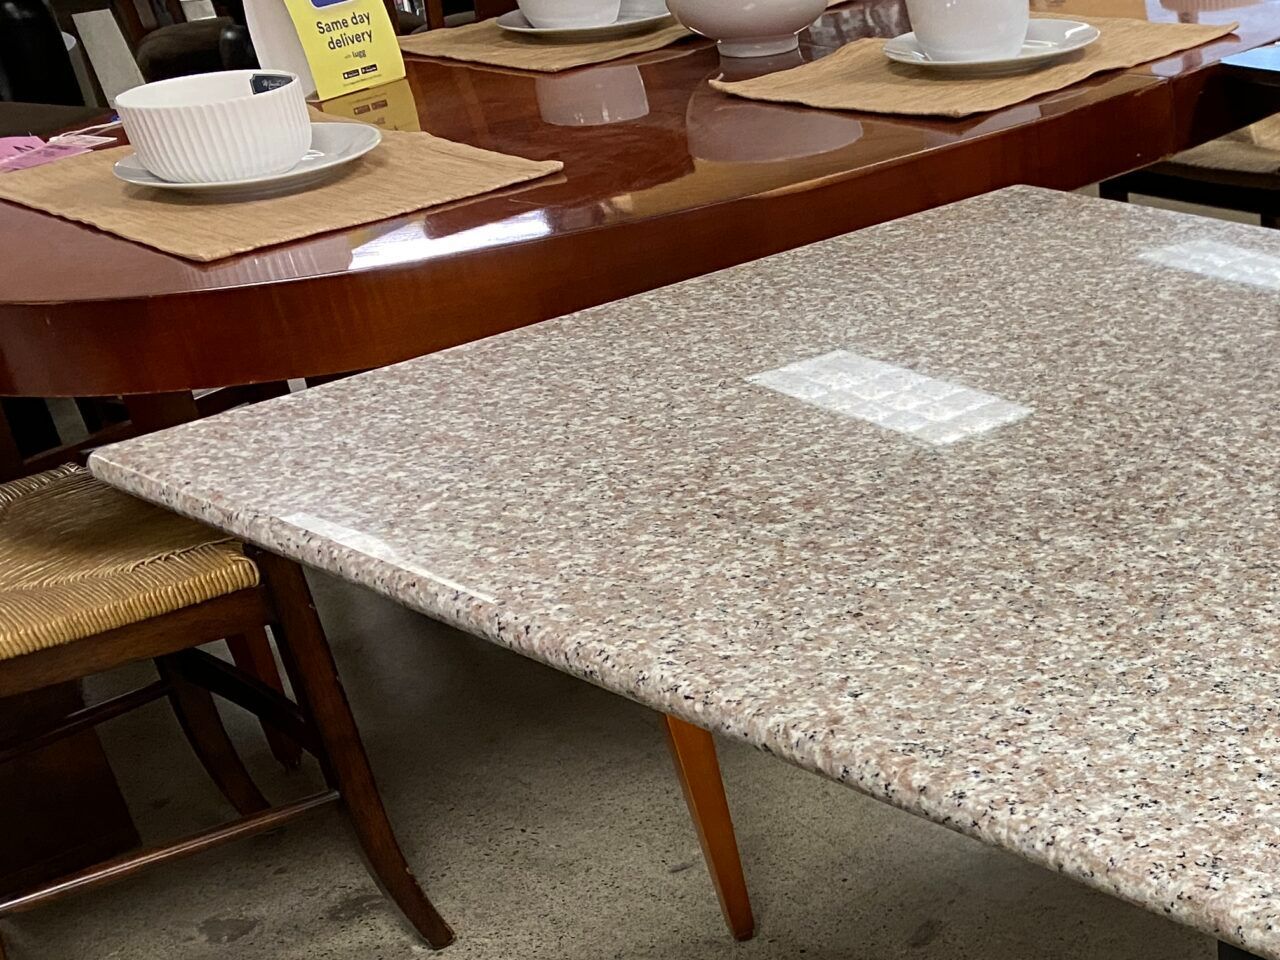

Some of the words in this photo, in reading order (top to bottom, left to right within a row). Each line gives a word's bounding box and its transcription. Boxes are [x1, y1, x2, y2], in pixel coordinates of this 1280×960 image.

[316, 18, 349, 34] Same
[351, 12, 371, 26] day
[328, 30, 373, 50] delivery
